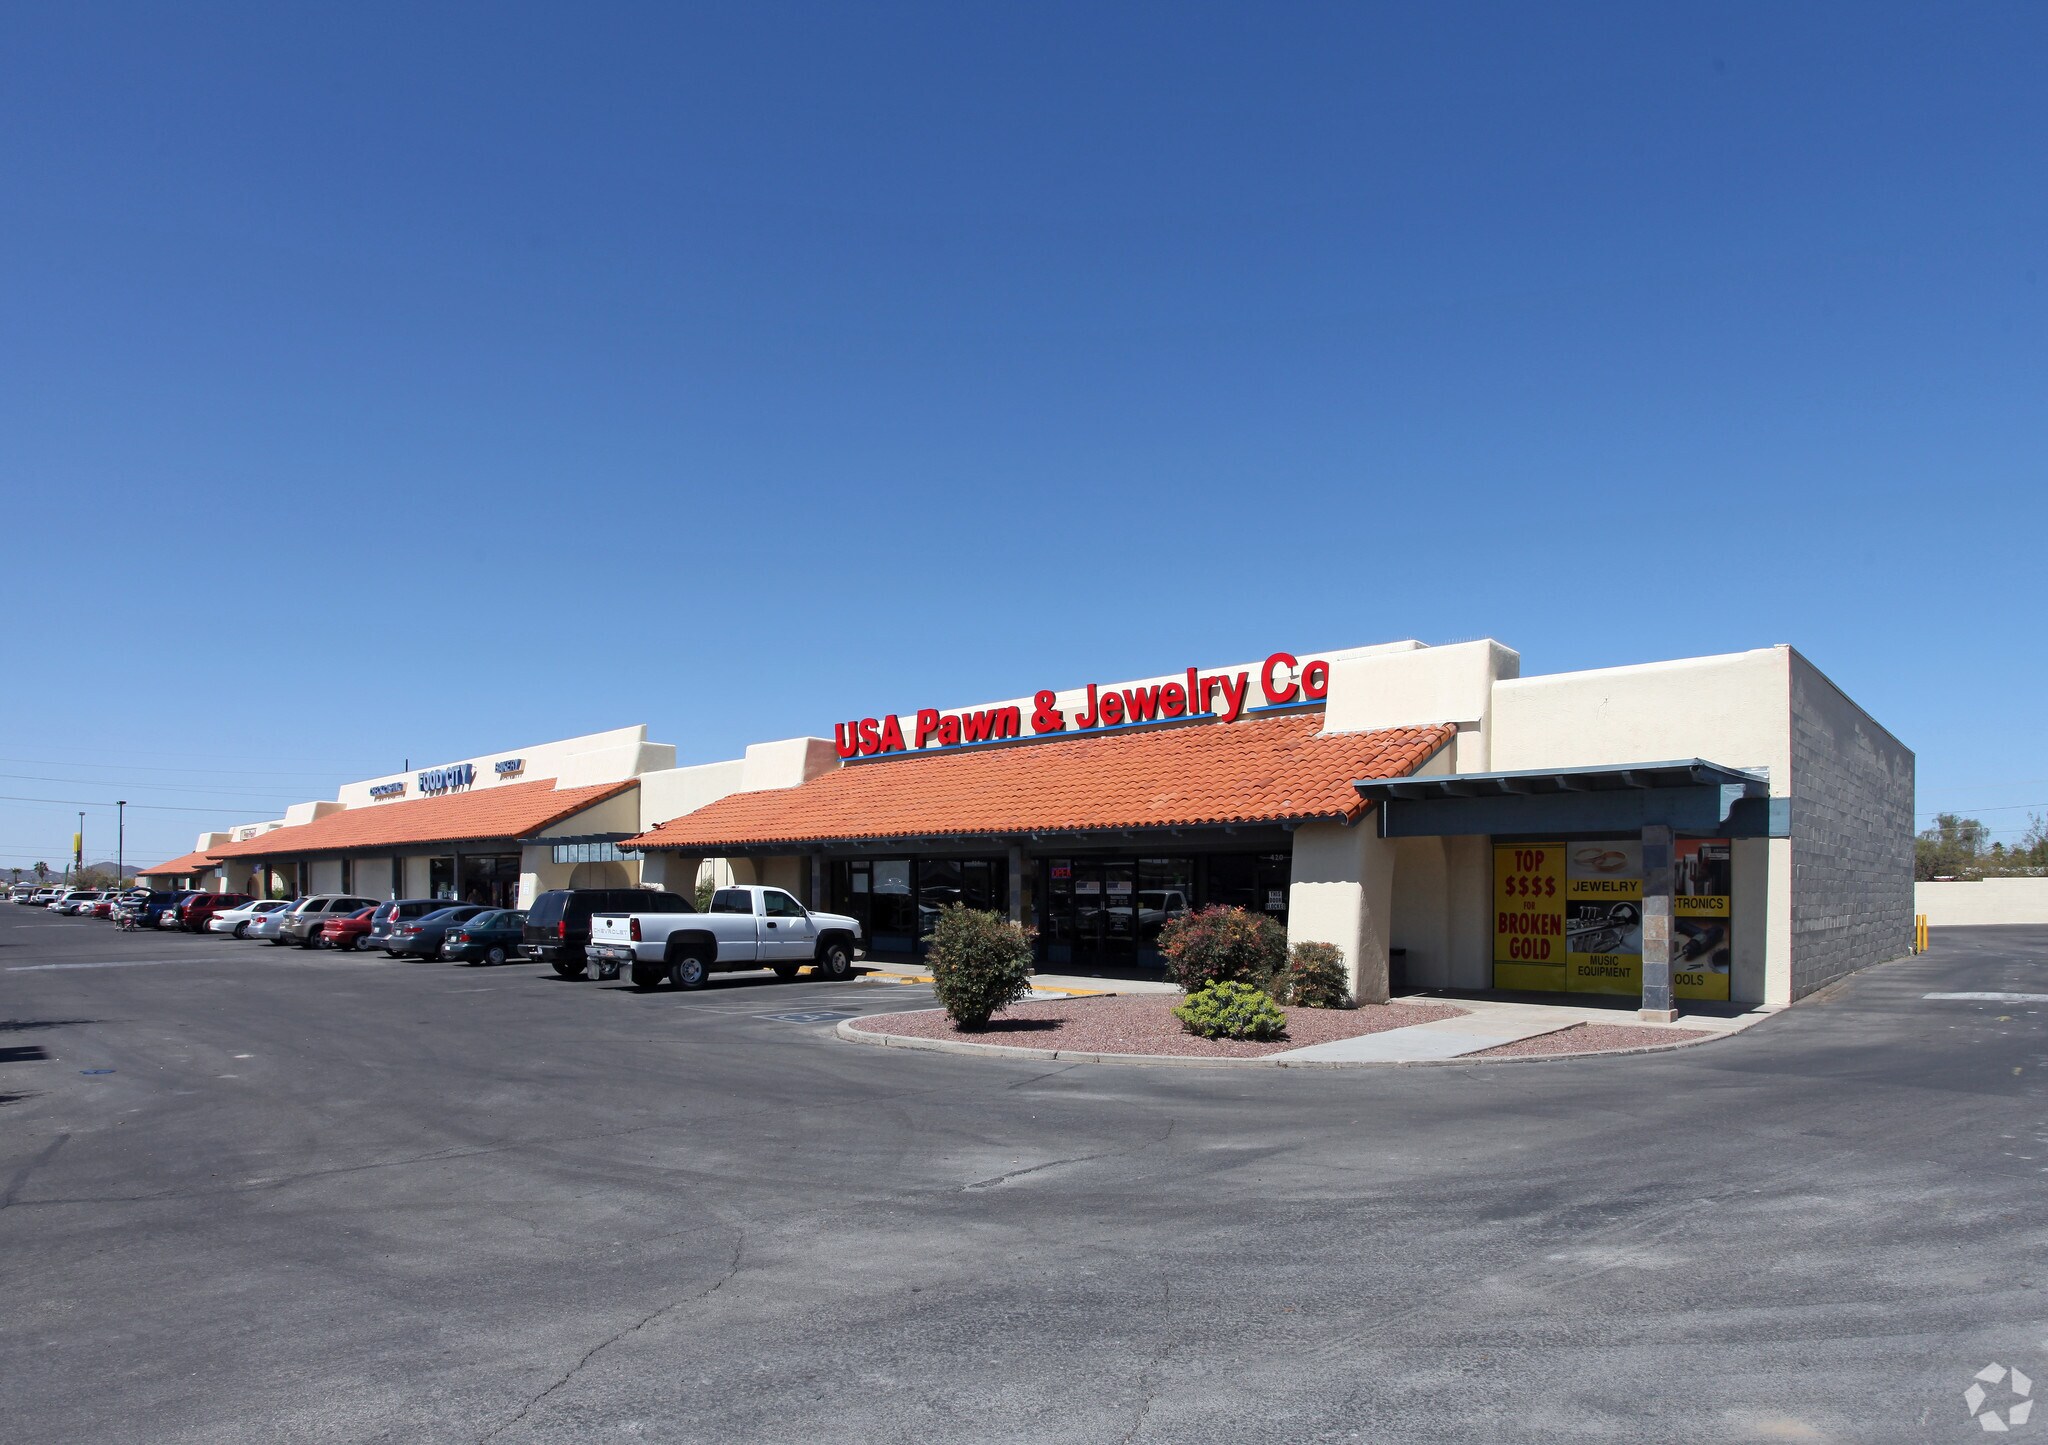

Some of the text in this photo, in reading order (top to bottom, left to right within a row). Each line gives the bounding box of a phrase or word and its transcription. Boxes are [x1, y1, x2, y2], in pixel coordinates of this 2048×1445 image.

[834, 652, 1328, 758] USA Pawn & Jewelry Co
[418, 763, 470, 791] FOOD CITY
[1515, 849, 1545, 873] TOP
[1505, 875, 1556, 898] $$$$
[1572, 880, 1638, 893] JEWELRY
[1523, 901, 1535, 911] FOR
[1674, 897, 1724, 910] TRONICS
[1498, 912, 1561, 936] BROKEN
[1509, 936, 1551, 960] GOLD
[1589, 955, 1619, 967] MUSIC
[1577, 966, 1632, 978] EQUIPMENT
[1674, 973, 1704, 986] OOLS
